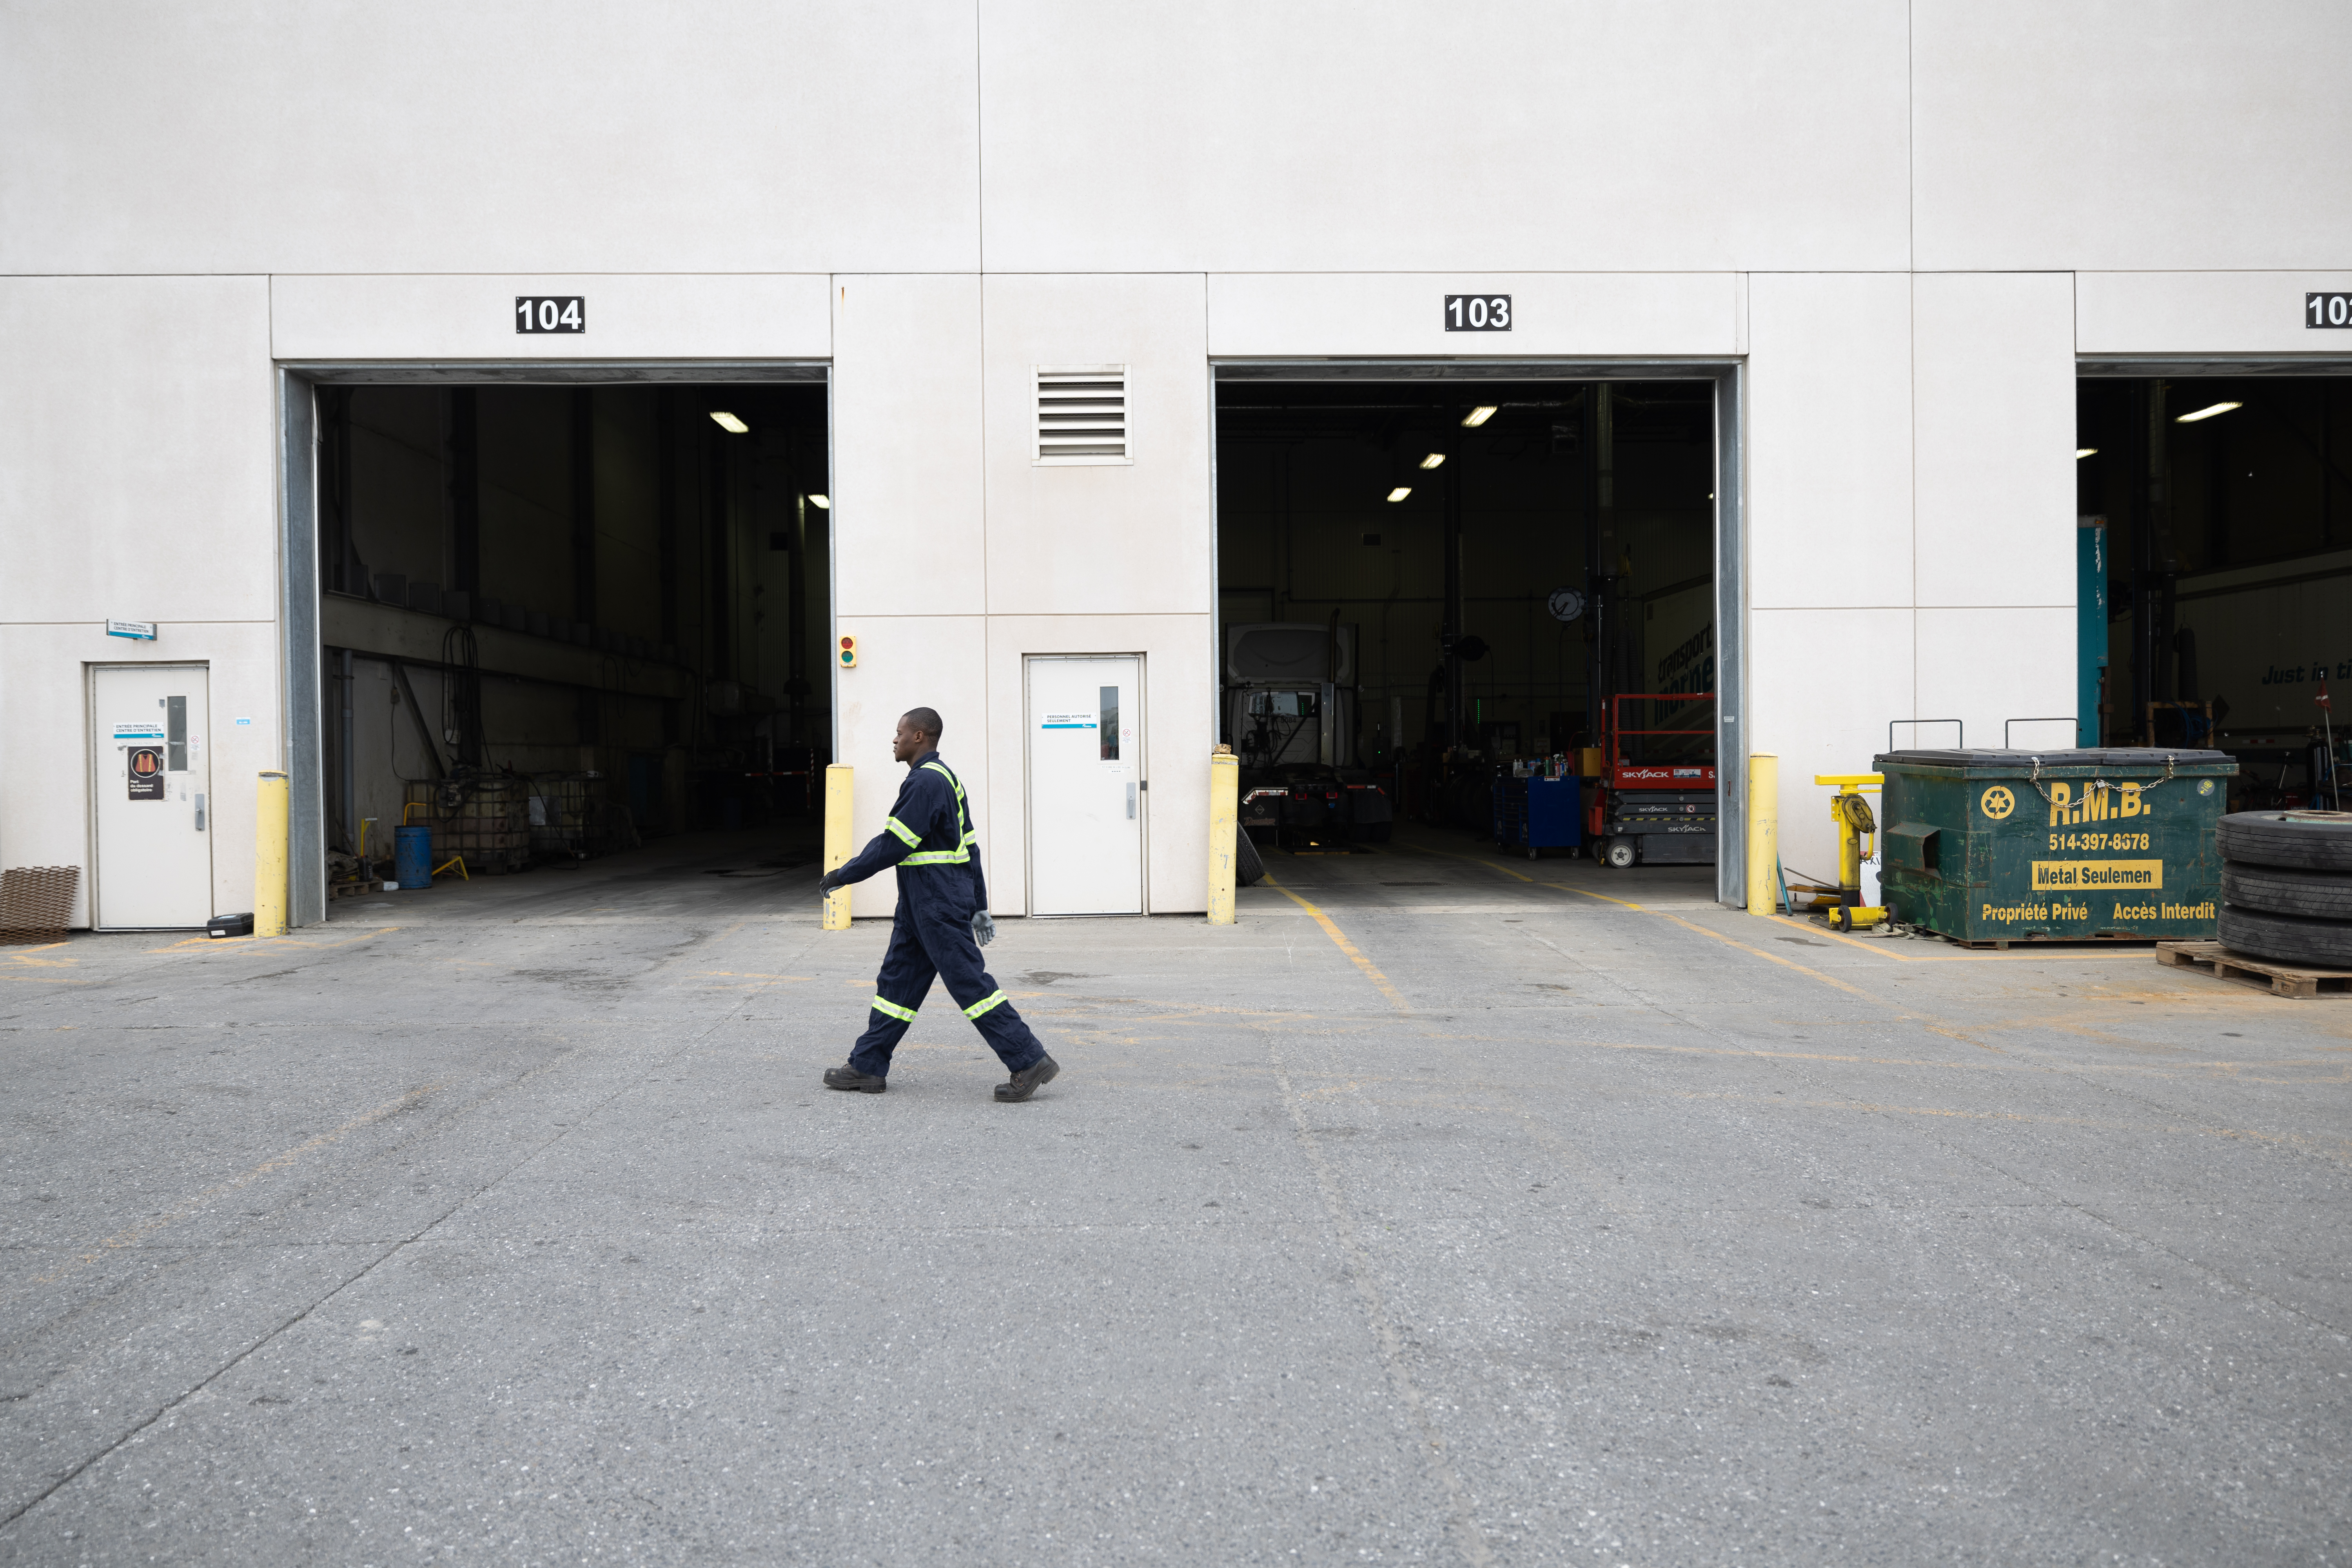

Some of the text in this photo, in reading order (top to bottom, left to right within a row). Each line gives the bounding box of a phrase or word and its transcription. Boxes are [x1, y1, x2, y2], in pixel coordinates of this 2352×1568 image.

[518, 299, 582, 330] 104
[1449, 298, 1509, 328] 103
[2309, 296, 2352, 325] 10
[1658, 620, 1712, 684] transport
[2262, 659, 2352, 685] Just in ti
[1622, 769, 1669, 779] SKYJACK
[2049, 782, 2151, 827] R.M.B.
[1243, 817, 1276, 826] Dynamique
[1668, 824, 1706, 833] SKYJACK
[2038, 867, 2076, 884] Metal
[1982, 902, 2215, 925] Propriété Privé Accès Interdit
